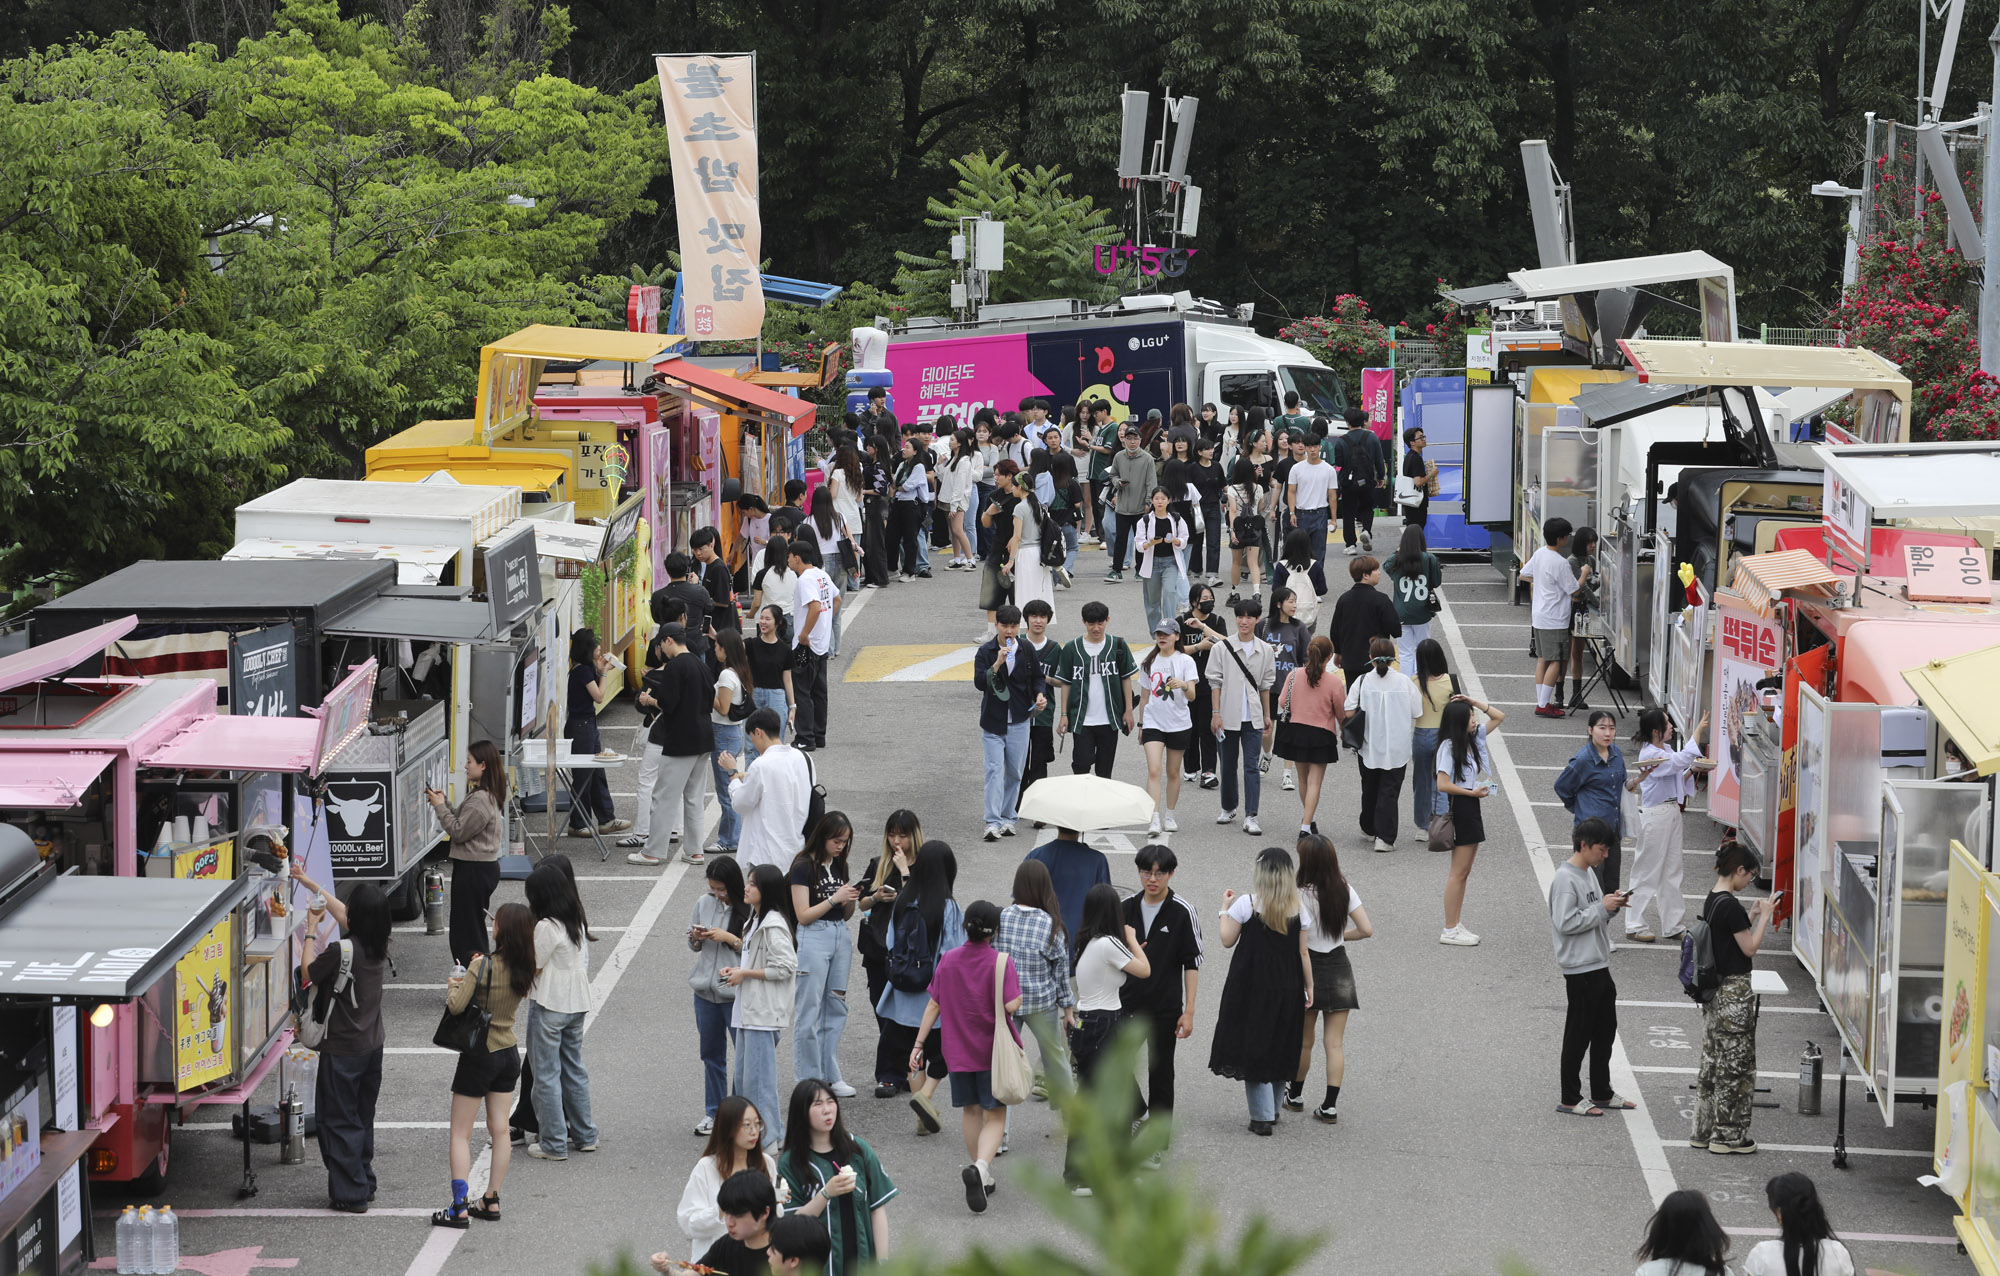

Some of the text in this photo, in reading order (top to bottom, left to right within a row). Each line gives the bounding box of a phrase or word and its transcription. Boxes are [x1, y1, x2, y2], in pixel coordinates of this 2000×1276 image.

[922, 364, 975, 382] 데이터도
[920, 382, 960, 399] 혜택도
[581, 445, 606, 461] 포장
[581, 468, 607, 487] 가능
[1910, 546, 1934, 577] 가맹
[1958, 547, 1982, 585] 010-
[1399, 574, 1428, 602] 98
[1723, 615, 1776, 667] 떡튀순
[365, 843, 384, 852] Beef
[195, 850, 217, 872] OOPS!
